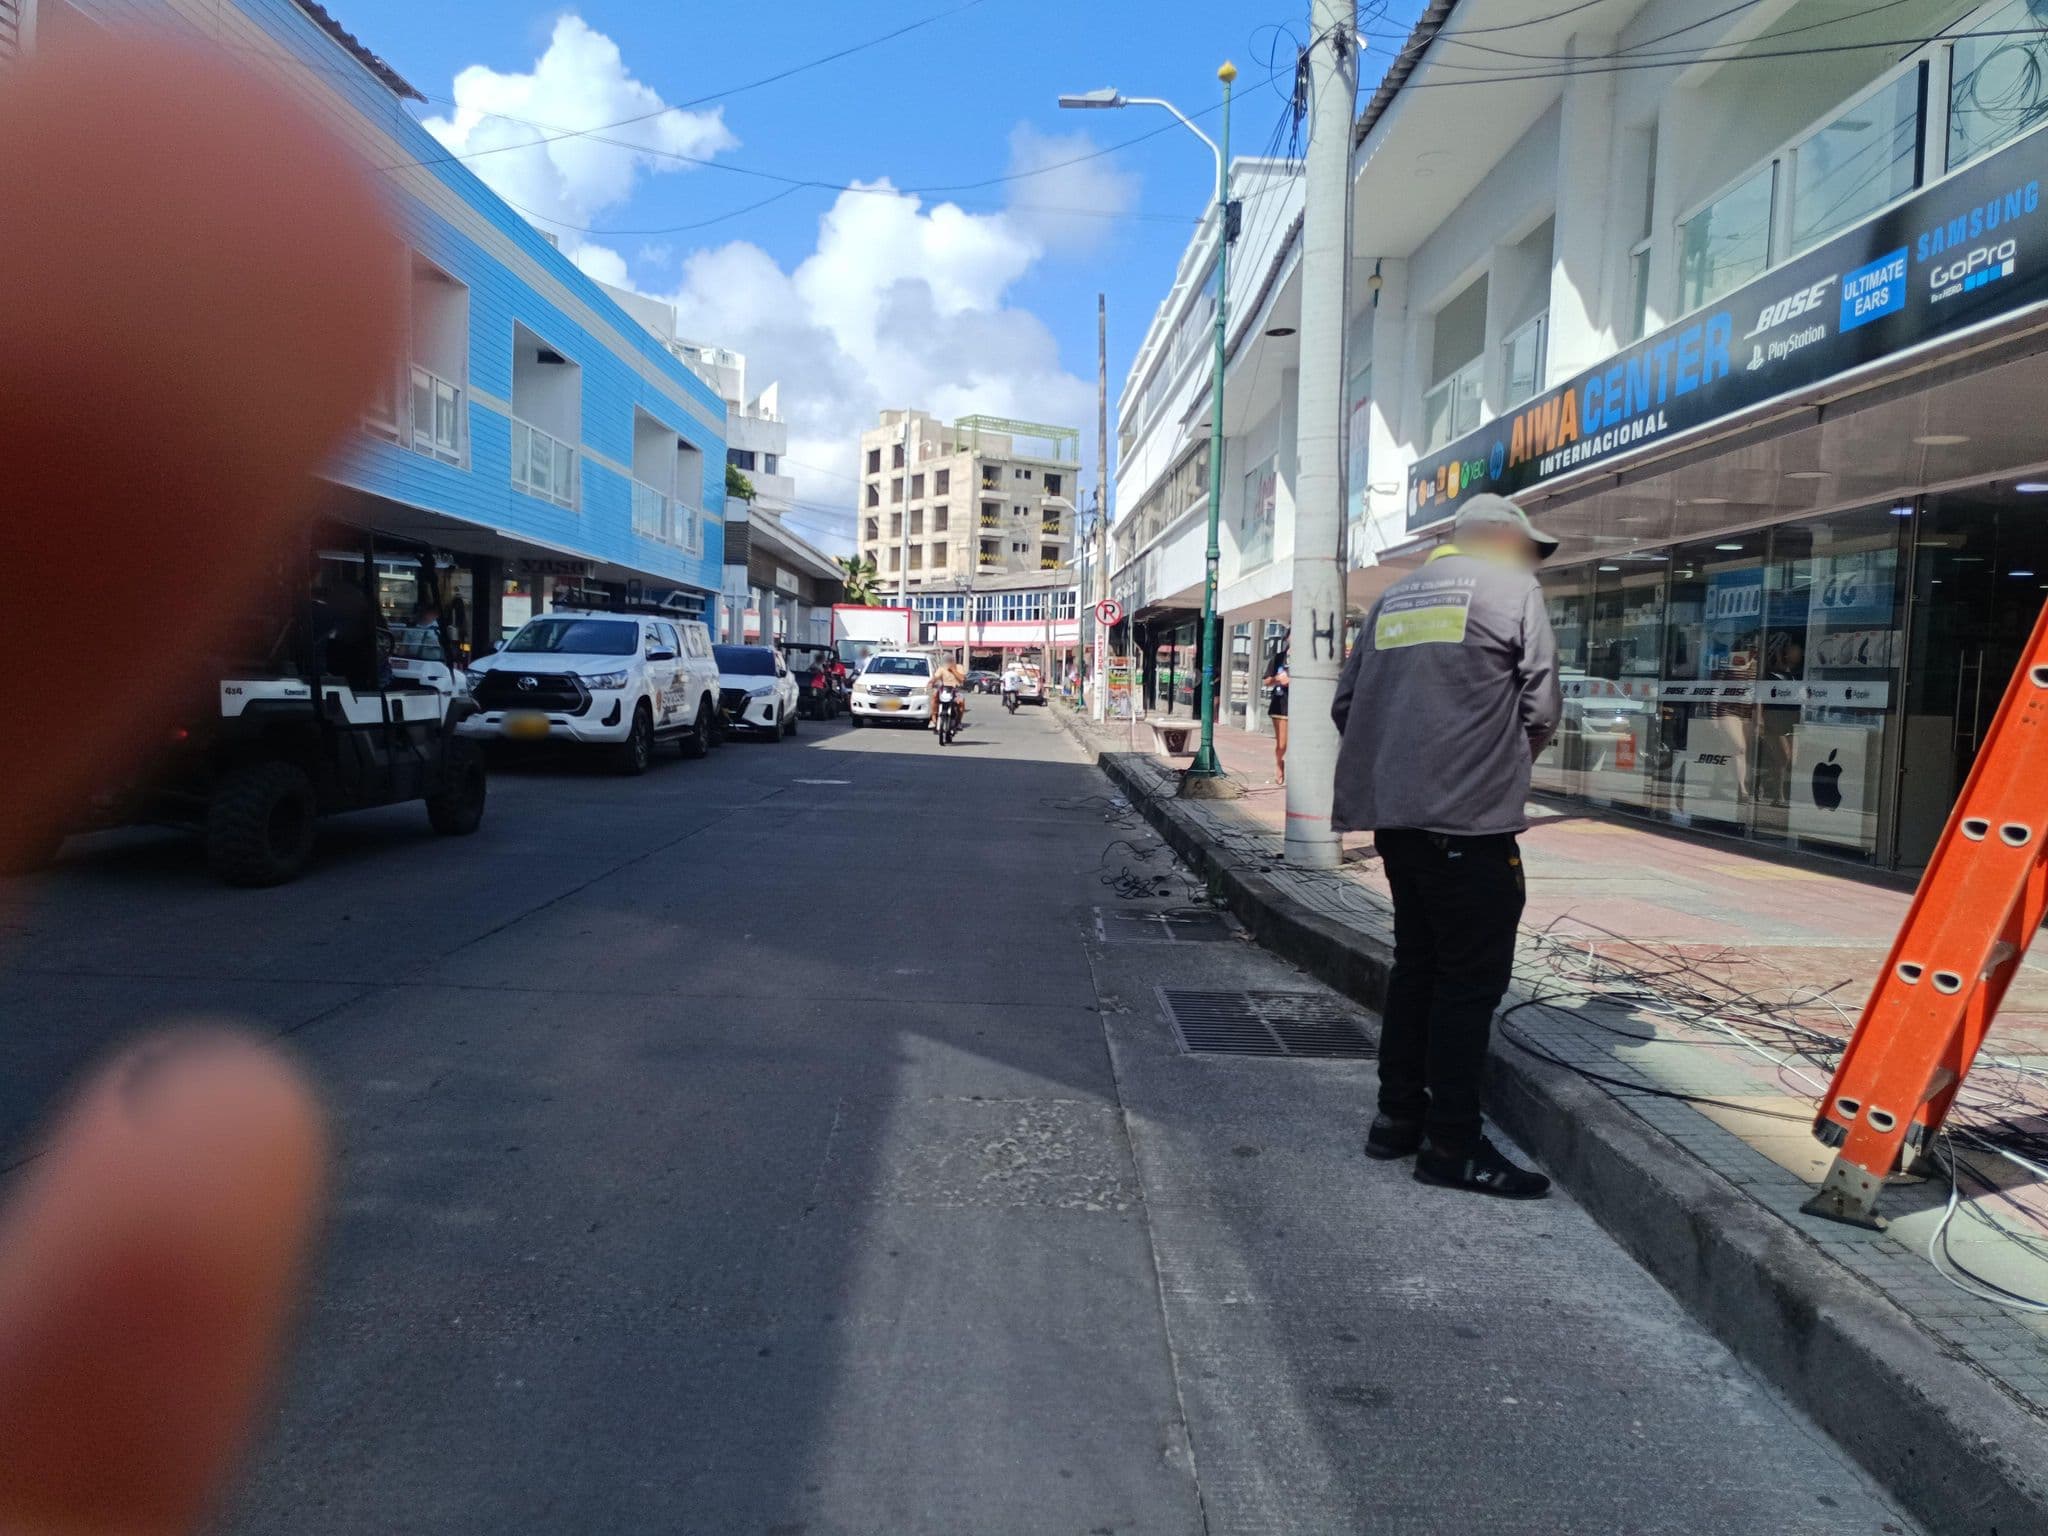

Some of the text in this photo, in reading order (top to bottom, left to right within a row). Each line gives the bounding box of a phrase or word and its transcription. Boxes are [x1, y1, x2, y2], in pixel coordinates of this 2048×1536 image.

[1917, 180, 2039, 263] SAMSUNG
[1844, 259, 1905, 301] ULTIMATE
[1930, 239, 2016, 289] GoPro
[1744, 274, 1839, 340] BOSE
[1854, 287, 1889, 317] EARS
[1768, 324, 1825, 360] PlayStation
[1508, 310, 1734, 469] AIWA CENTER
[1539, 410, 1668, 476] INTERNACIONAL
[1104, 604, 1115, 620] P
[1312, 608, 1334, 660] H
[1694, 753, 1731, 766] BOSE
